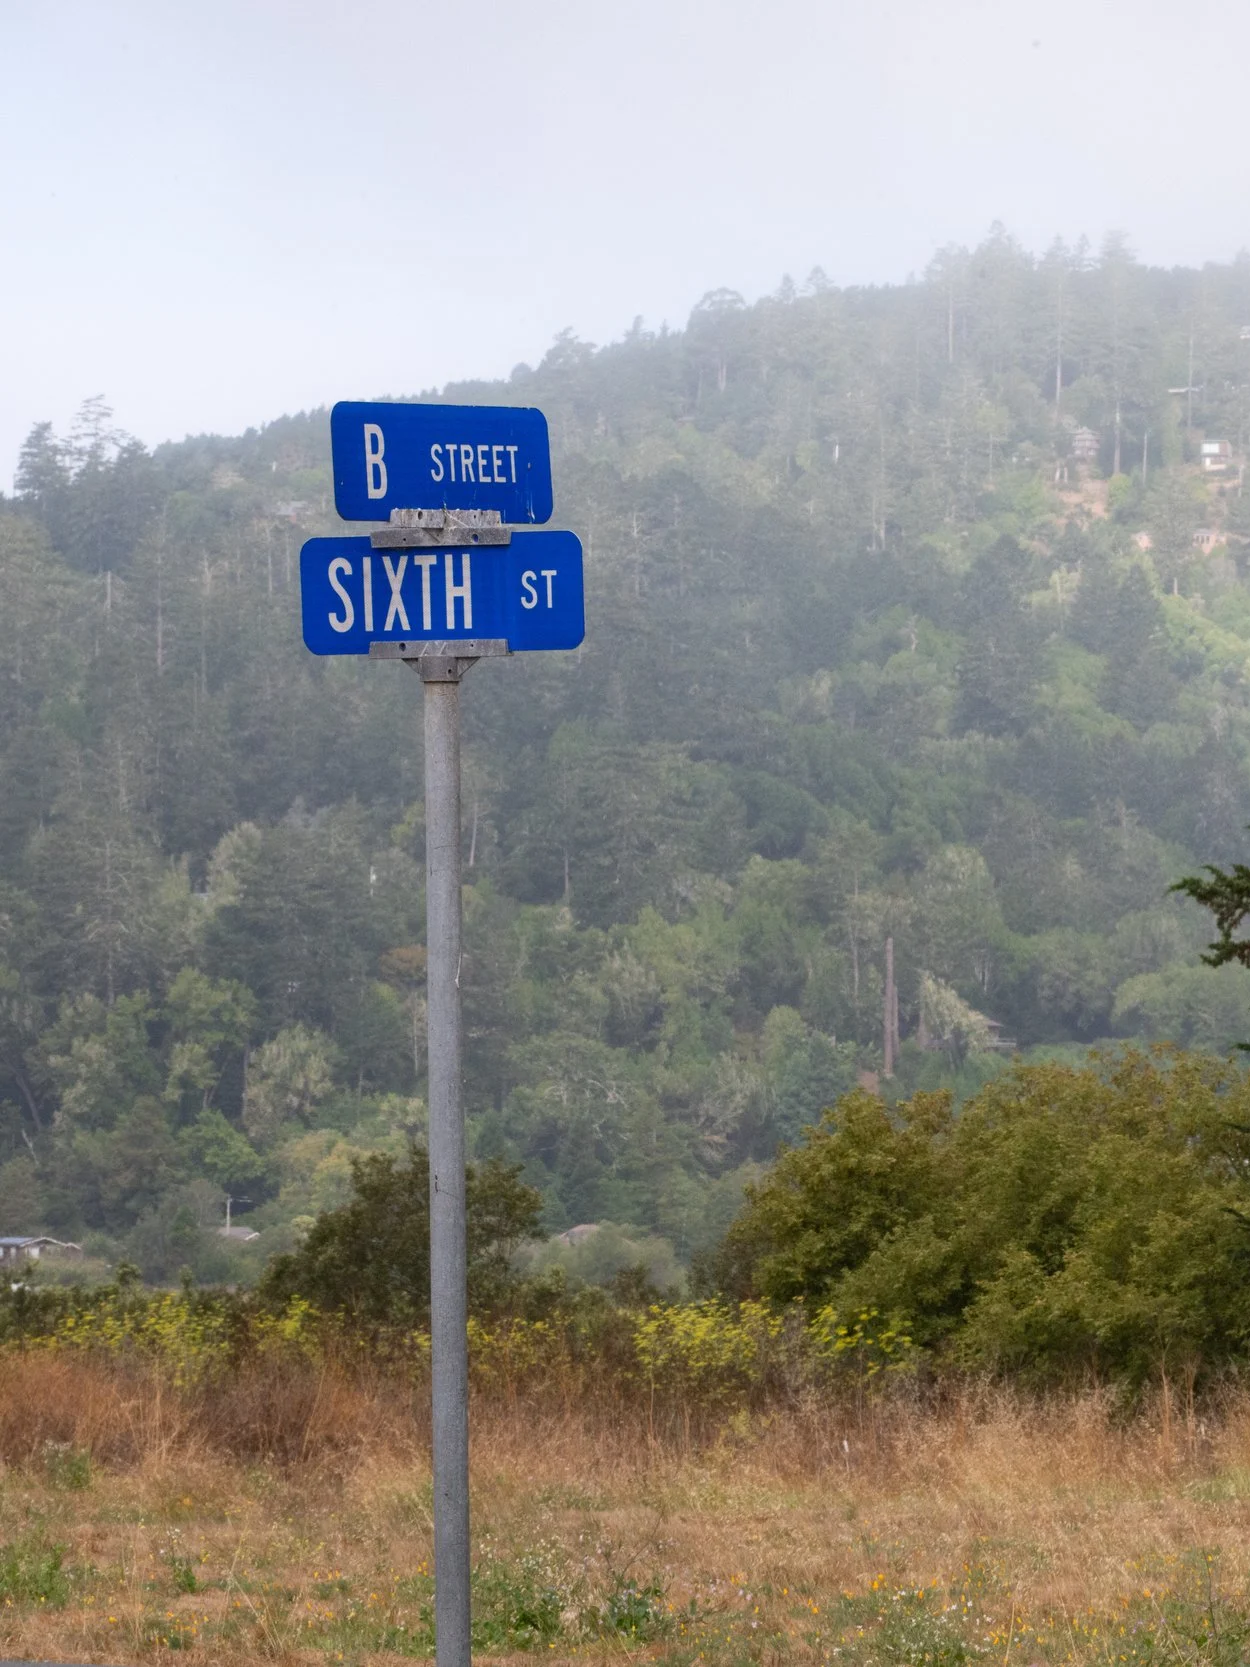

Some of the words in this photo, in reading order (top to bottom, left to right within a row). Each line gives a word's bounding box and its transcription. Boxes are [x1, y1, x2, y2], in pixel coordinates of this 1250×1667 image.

[363, 423, 388, 499] B
[430, 443, 518, 483] STREET
[327, 553, 473, 633] SIXTH
[520, 569, 557, 609] ST
